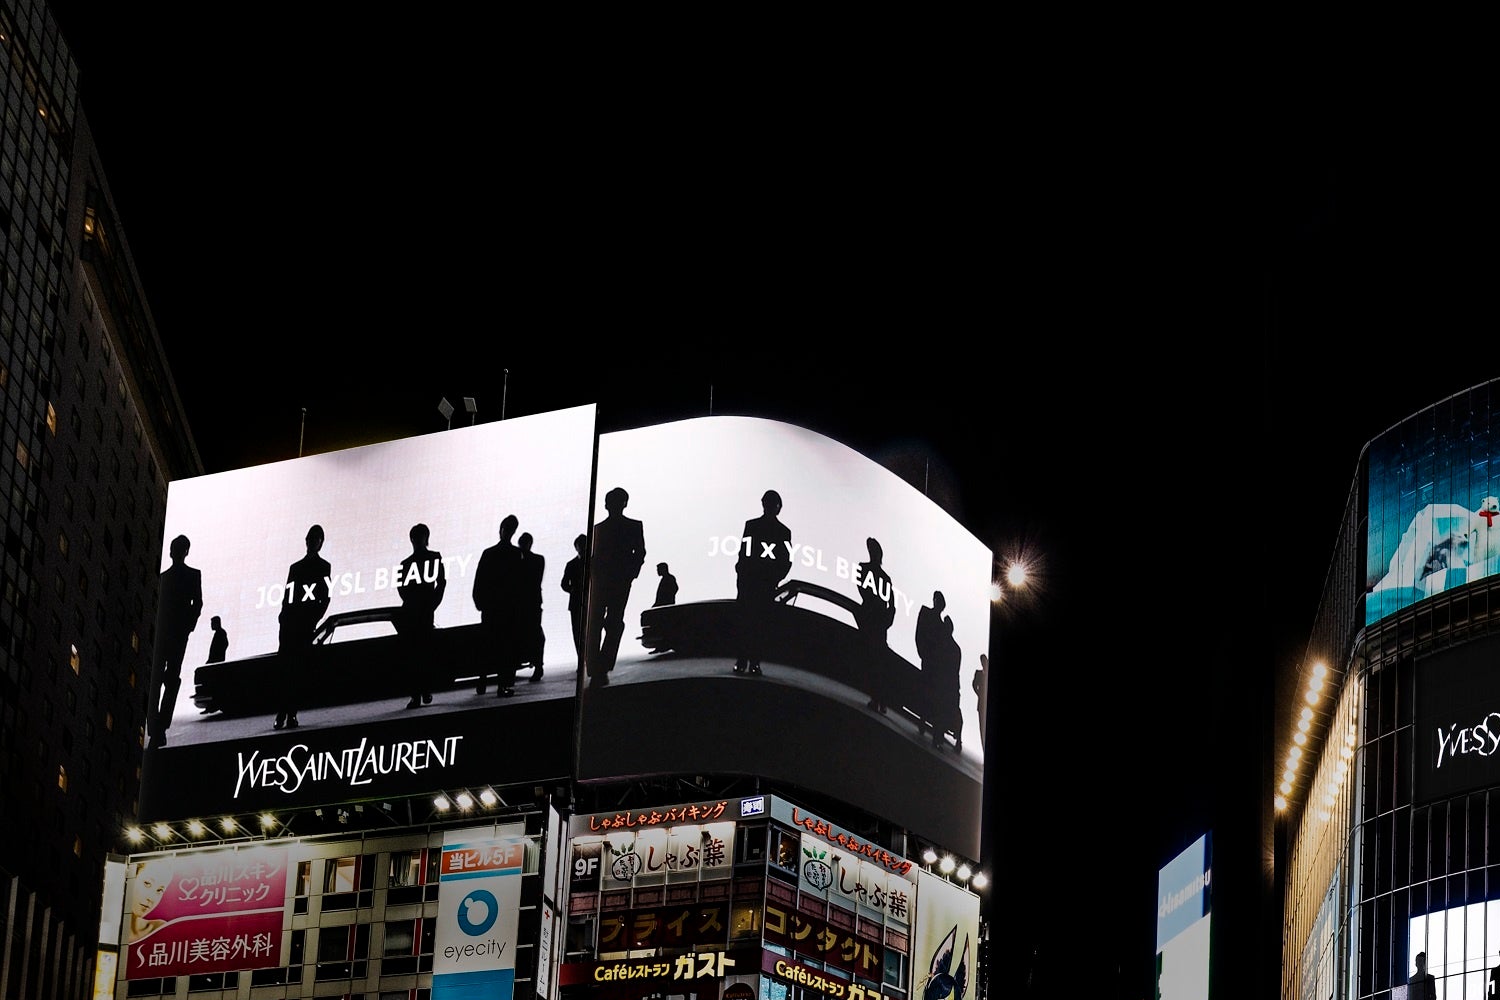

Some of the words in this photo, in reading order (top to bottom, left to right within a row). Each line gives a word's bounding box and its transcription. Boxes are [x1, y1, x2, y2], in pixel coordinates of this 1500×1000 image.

[255, 581, 295, 610] JO1
[302, 583, 316, 602] x
[323, 571, 366, 600] YSL
[375, 553, 473, 590] BEAUTY
[708, 536, 752, 558] JO1
[760, 541, 776, 560] x
[785, 540, 827, 572] YSL
[836, 556, 914, 617] BEAUTY
[588, 800, 729, 832] しゃぶしゃぶバイキング
[647, 838, 726, 872] しゃぶ葉
[792, 806, 913, 876] しゃぶしゃぶバイキング
[200, 861, 281, 887] 品川スキン
[449, 847, 515, 871] 当ビル5F
[574, 857, 599, 877] 9F
[199, 882, 271, 907] クリニック
[839, 866, 908, 918] しゃぶ葉
[600, 905, 724, 944] プライス
[765, 905, 879, 970] コンタクト
[148, 931, 274, 968] 品川美容外科
[444, 938, 507, 963] eyecity
[673, 951, 736, 981] ガスト
